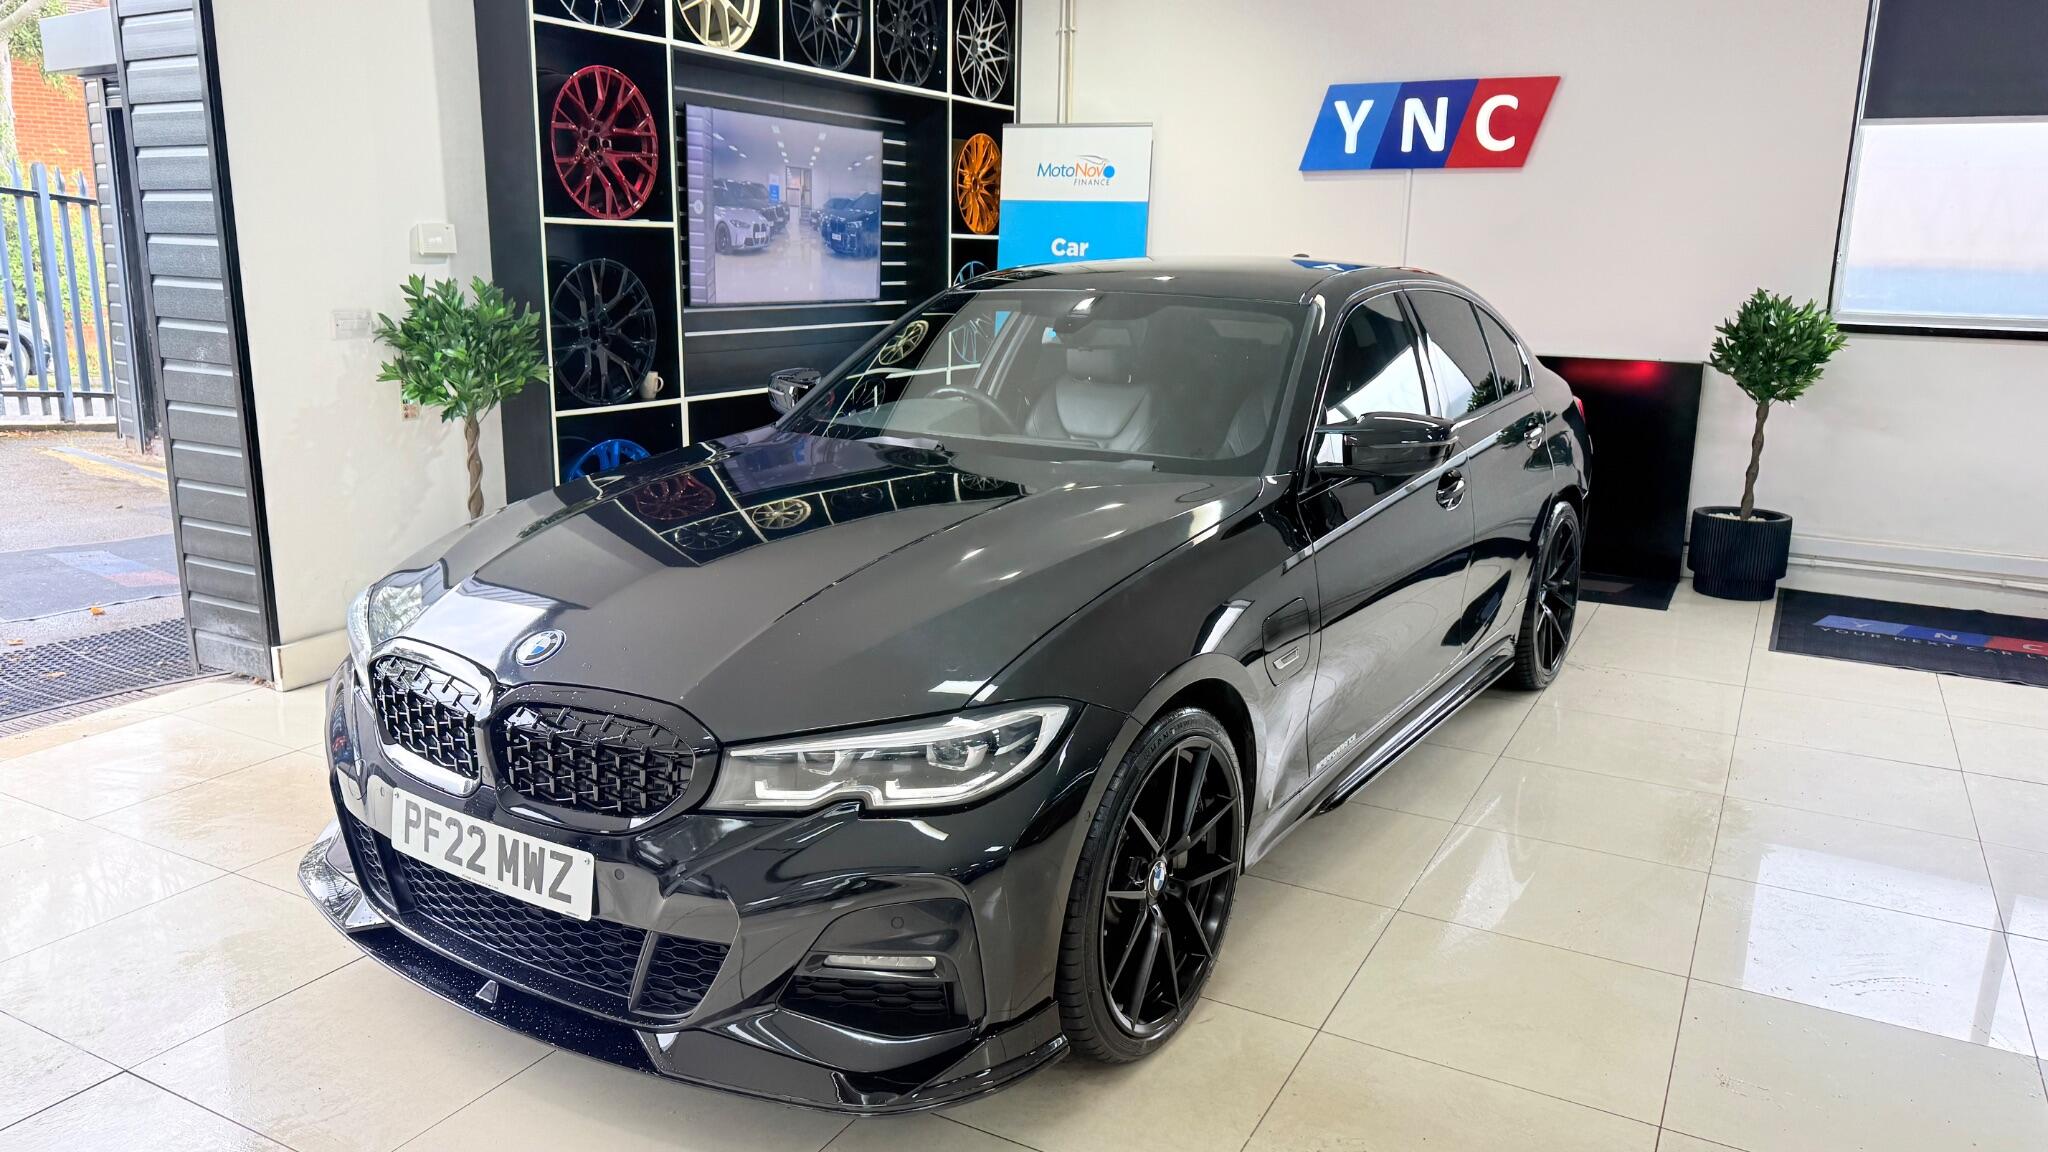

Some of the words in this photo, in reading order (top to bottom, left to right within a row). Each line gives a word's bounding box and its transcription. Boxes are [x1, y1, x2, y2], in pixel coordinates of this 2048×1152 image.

[1334, 94, 1519, 154] YNC
[1073, 178, 1110, 186] FINANCE
[1051, 238, 1089, 257] Car
[1820, 627, 1881, 639] YOUR
[1894, 636, 1954, 648] NEXT
[1966, 646, 2013, 656] CAR
[404, 799, 488, 876] PF22
[498, 833, 574, 905] MWZ
